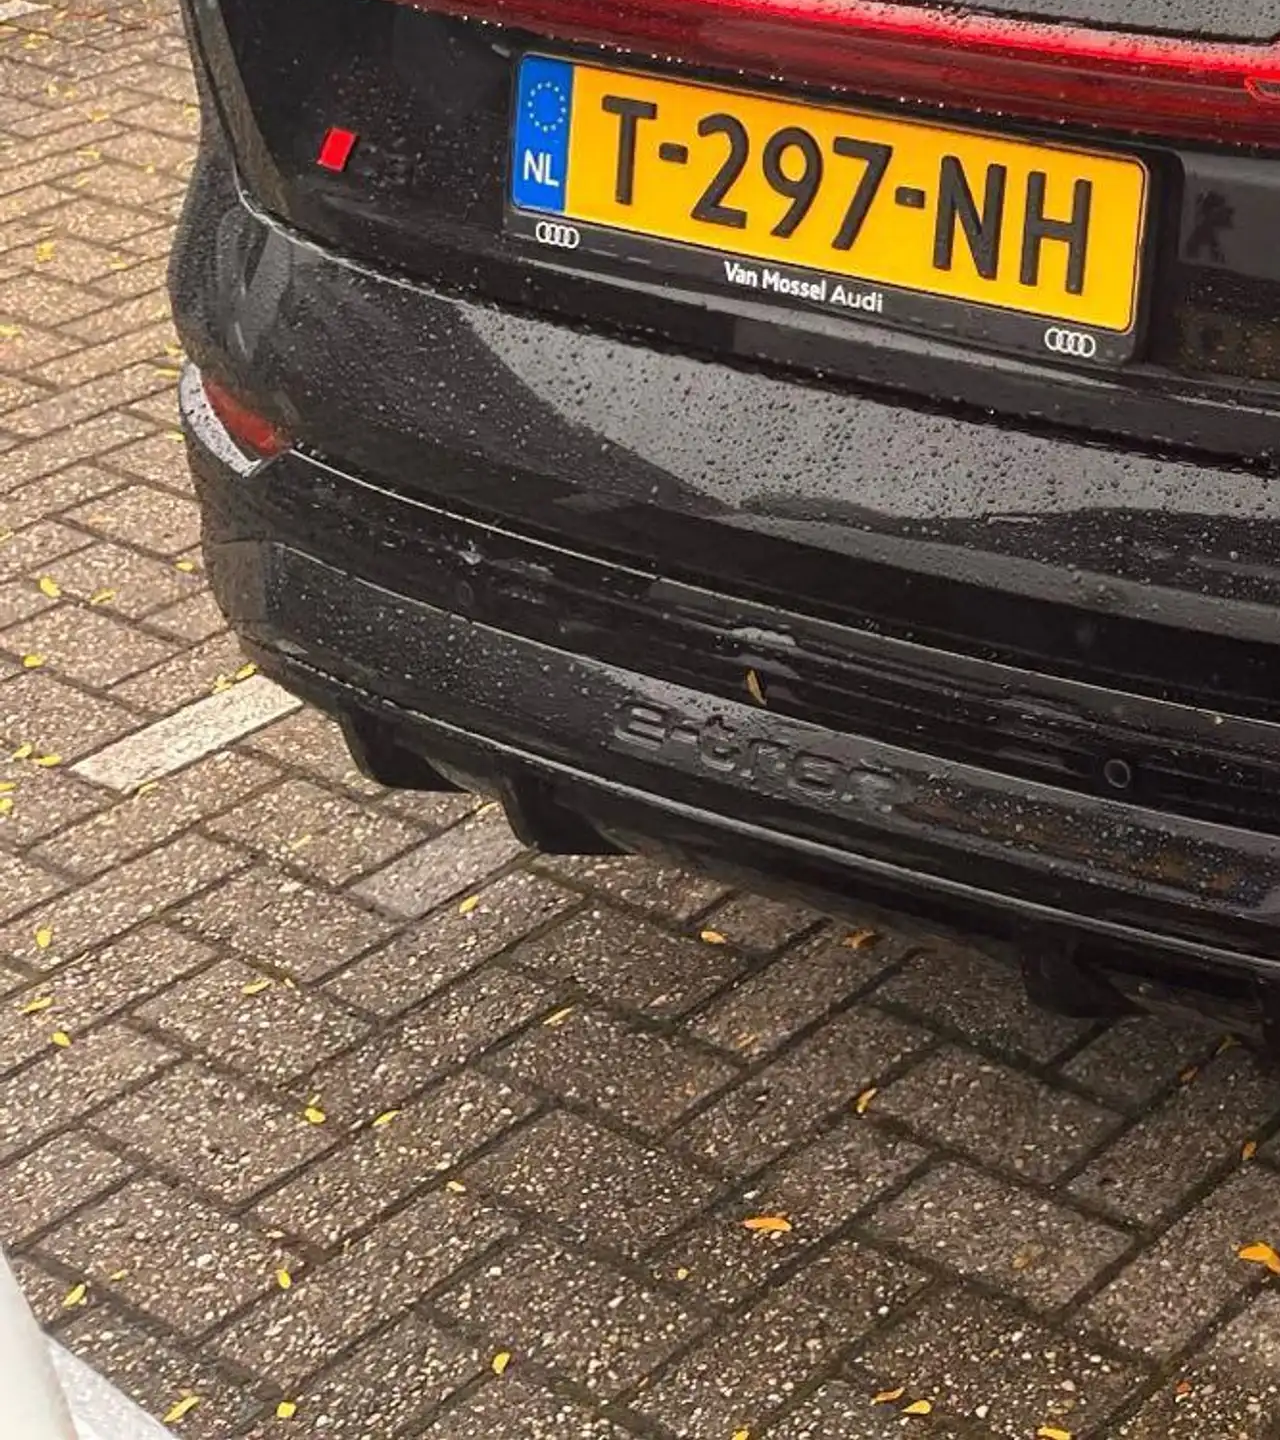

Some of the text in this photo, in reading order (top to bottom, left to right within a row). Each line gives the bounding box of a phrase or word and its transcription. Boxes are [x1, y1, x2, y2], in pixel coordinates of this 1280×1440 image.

[523, 148, 560, 189] NL
[602, 95, 1092, 296] T-297-NH
[723, 261, 884, 313] Van Mossel Audi
